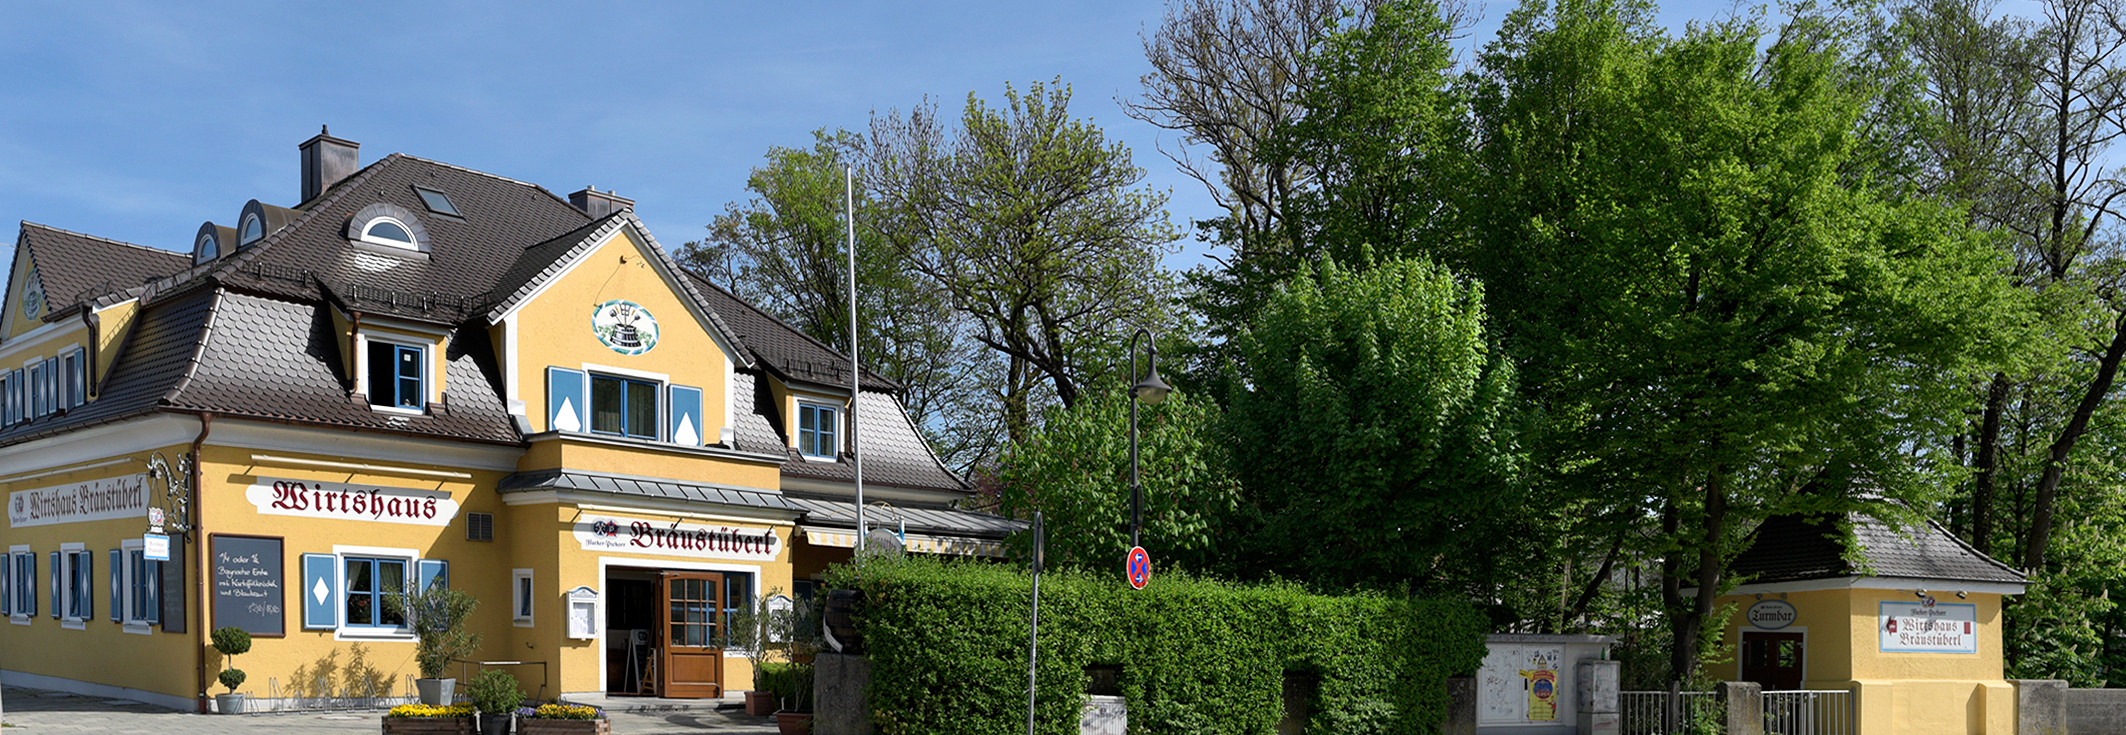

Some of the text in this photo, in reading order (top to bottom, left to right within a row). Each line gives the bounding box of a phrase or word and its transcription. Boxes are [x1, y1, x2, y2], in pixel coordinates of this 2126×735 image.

[30, 477, 143, 520] Wirtshaus Bräustüberl
[272, 480, 437, 520] Wirtshaus
[629, 520, 772, 555] Bräustüberl
[1752, 609, 1793, 622] Turmbar
[1902, 618, 1958, 633] Wirtshaus
[1899, 632, 1962, 646] Bräustüberl
